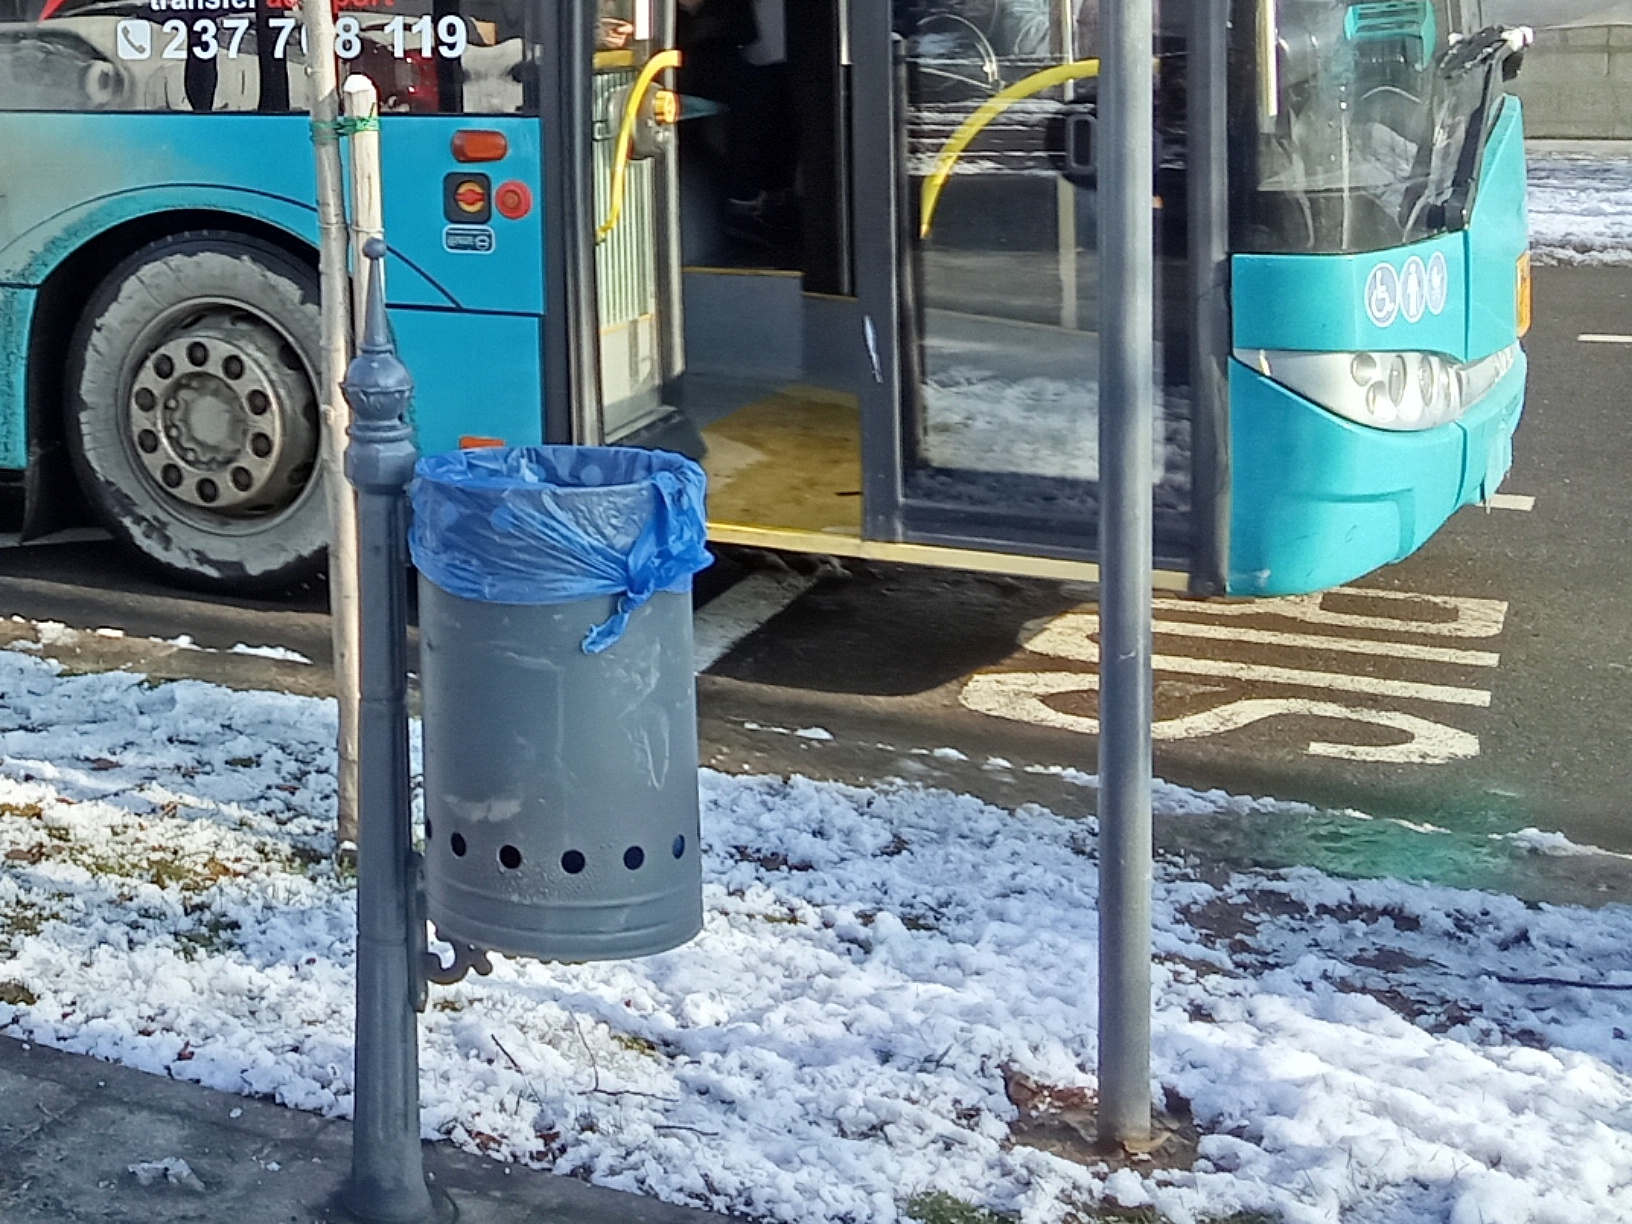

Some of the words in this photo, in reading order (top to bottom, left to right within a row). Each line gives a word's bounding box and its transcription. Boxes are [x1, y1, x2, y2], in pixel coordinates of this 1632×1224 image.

[162, 18, 250, 60] 237
[269, 16, 362, 60] 78
[383, 14, 467, 59] 119
